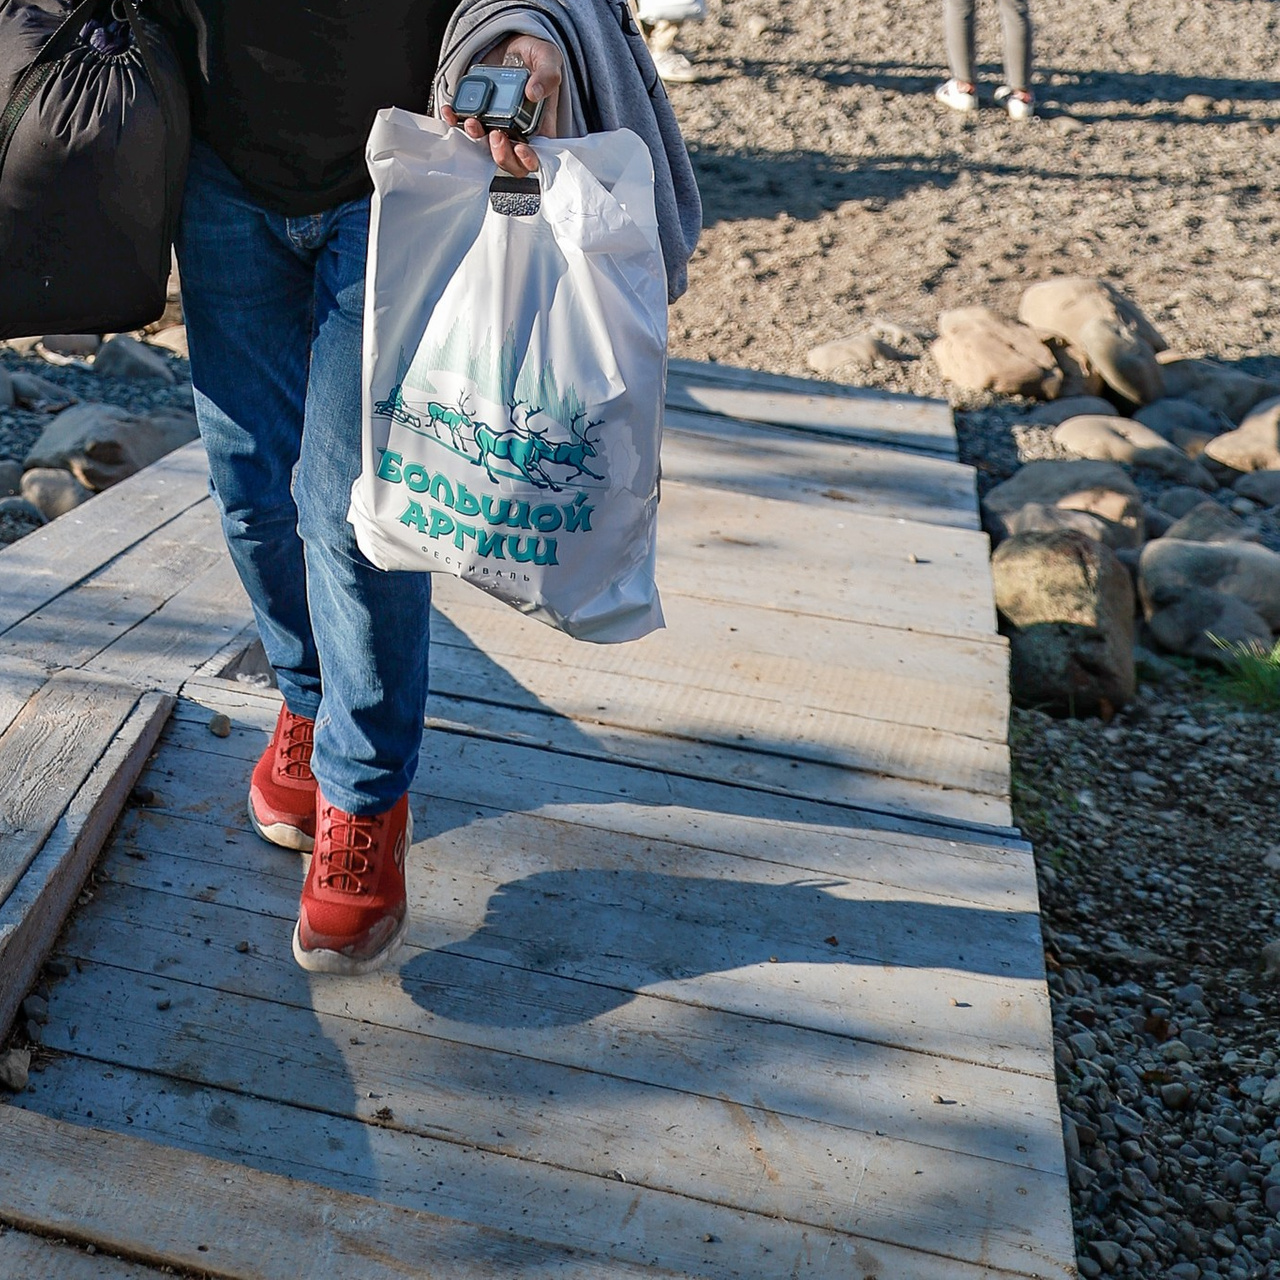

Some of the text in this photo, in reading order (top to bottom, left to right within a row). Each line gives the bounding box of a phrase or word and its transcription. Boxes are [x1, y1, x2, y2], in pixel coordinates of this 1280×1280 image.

[376, 447, 595, 533] БОЛЬШОЙ
[398, 497, 559, 565] АРГИШ
[421, 545, 531, 582] ФЕСТИВАЛЬ
